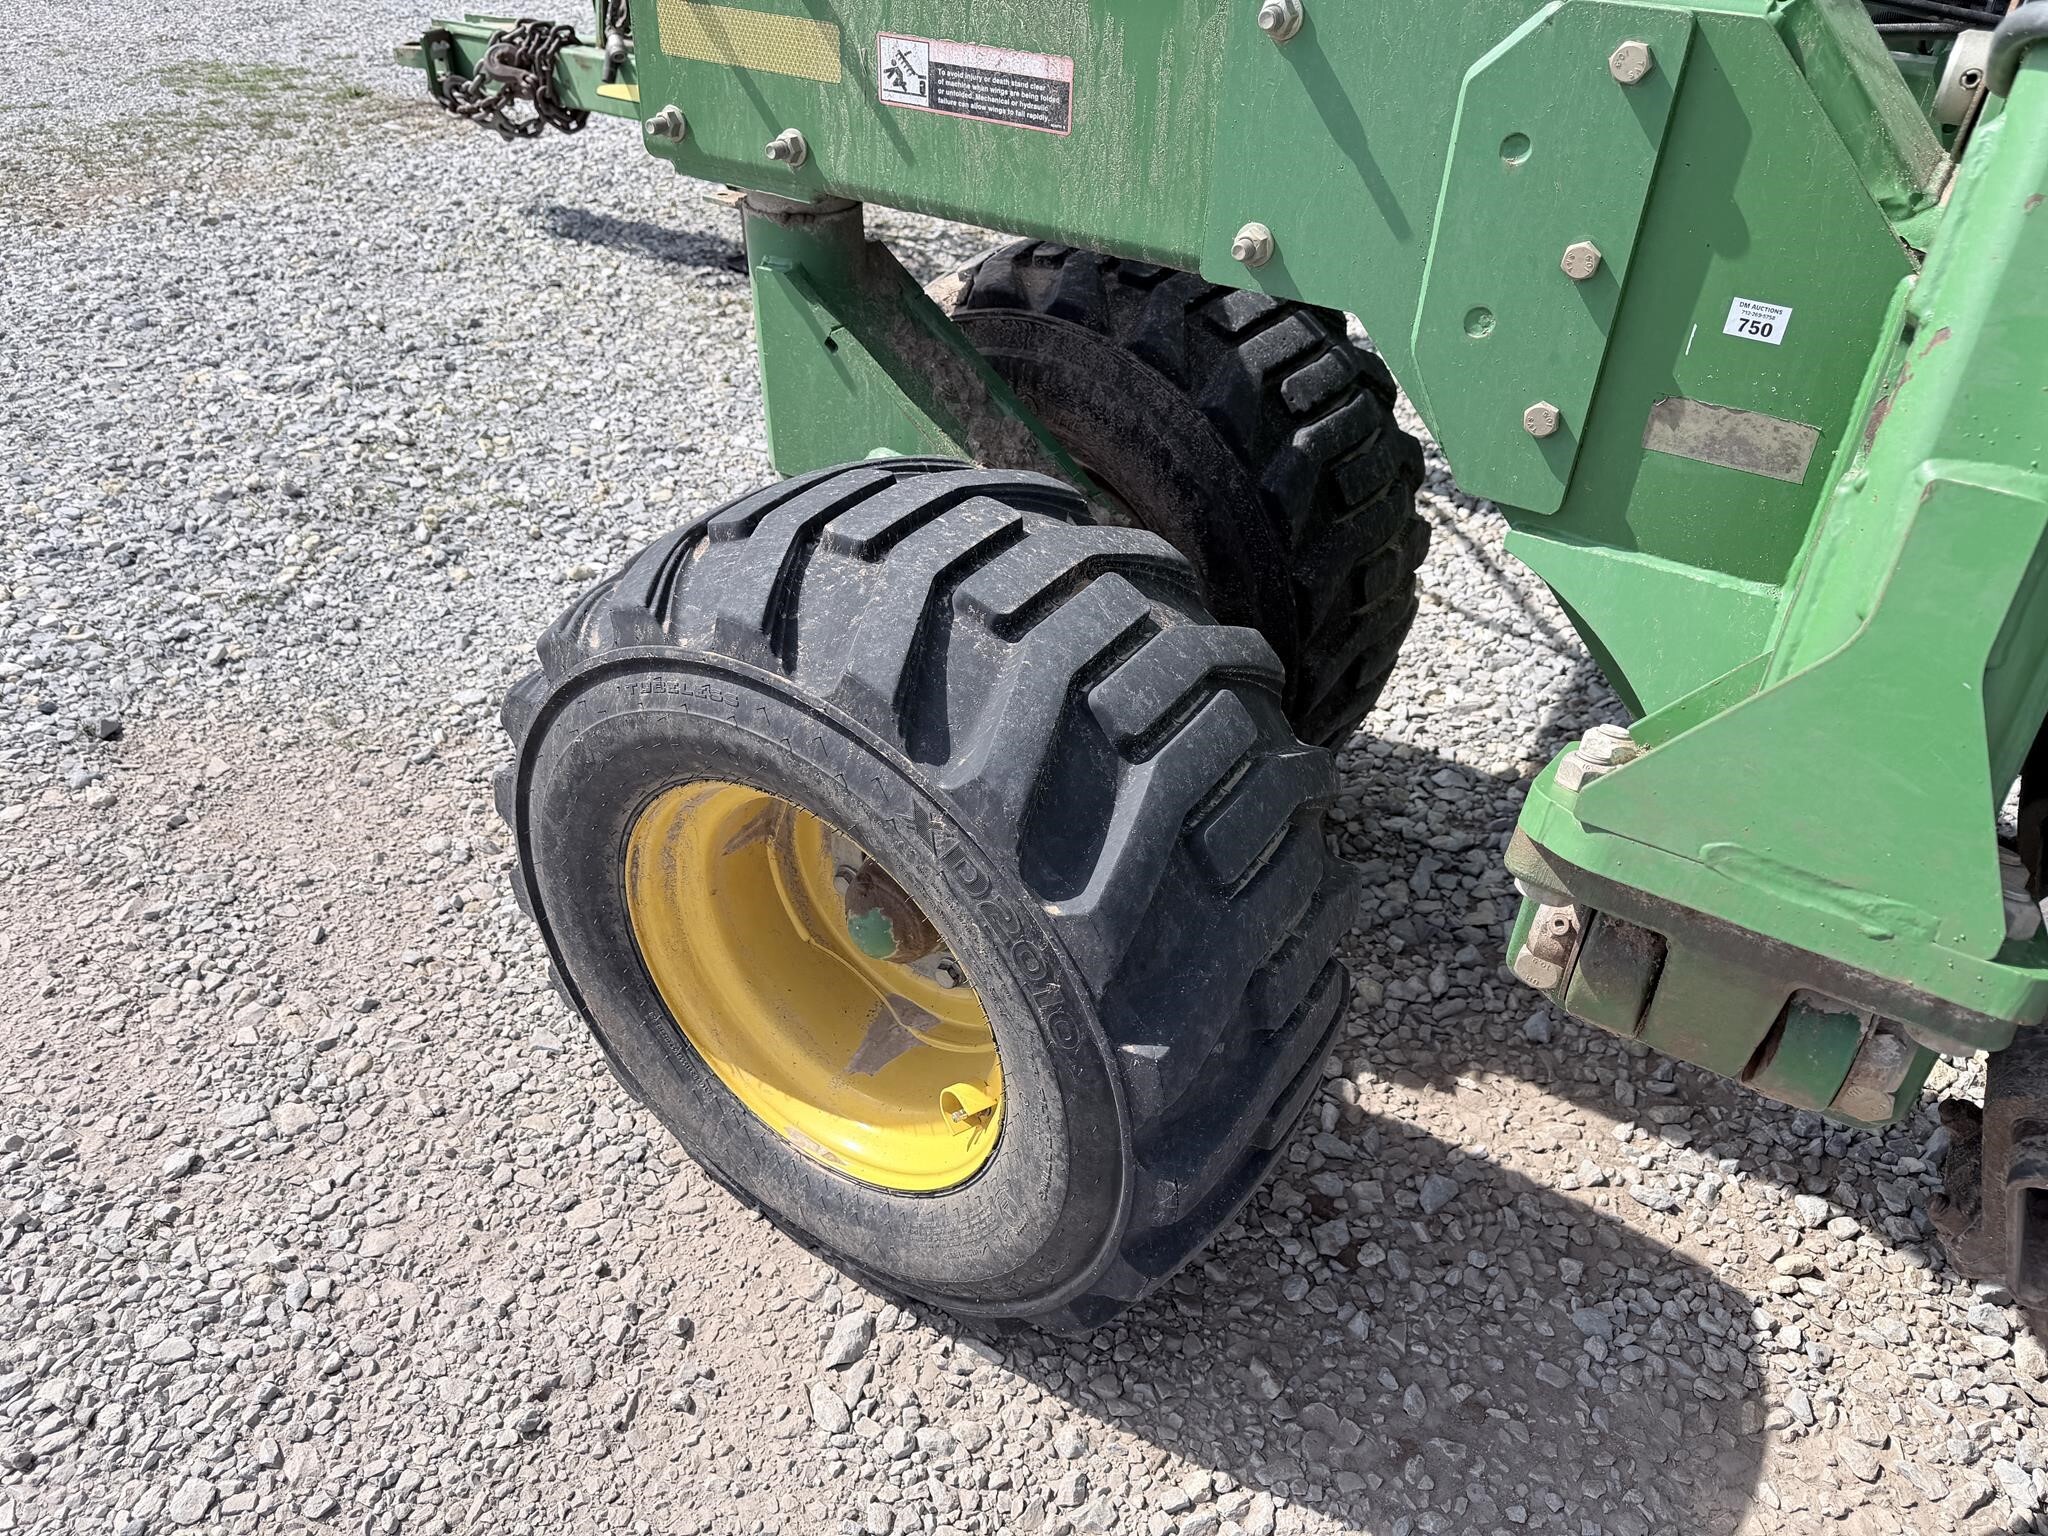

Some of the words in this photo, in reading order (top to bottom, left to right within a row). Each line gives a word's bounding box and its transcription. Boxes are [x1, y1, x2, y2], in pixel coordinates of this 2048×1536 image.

[937, 68, 946, 76] To
[964, 72, 982, 82] injury
[992, 77, 1010, 86] death
[1011, 79, 1028, 88] stand
[1030, 82, 1046, 90] clear
[945, 81, 970, 90] machine
[972, 84, 989, 92] when
[990, 87, 1008, 96] wings
[1021, 91, 1038, 101] being
[938, 97, 957, 106] failure
[970, 102, 986, 110] allow
[988, 106, 1006, 115] wings
[1015, 110, 1025, 118] fall
[1026, 113, 1050, 122] rapidly.
[975, 94, 1010, 105] Mechanical
[1020, 101, 1049, 111] hydraulic
[1751, 304, 1784, 315] AUCTIONS
[1738, 318, 1773, 338] 750
[626, 680, 739, 708] TUBELESS
[896, 798, 1081, 1050] XD2010
